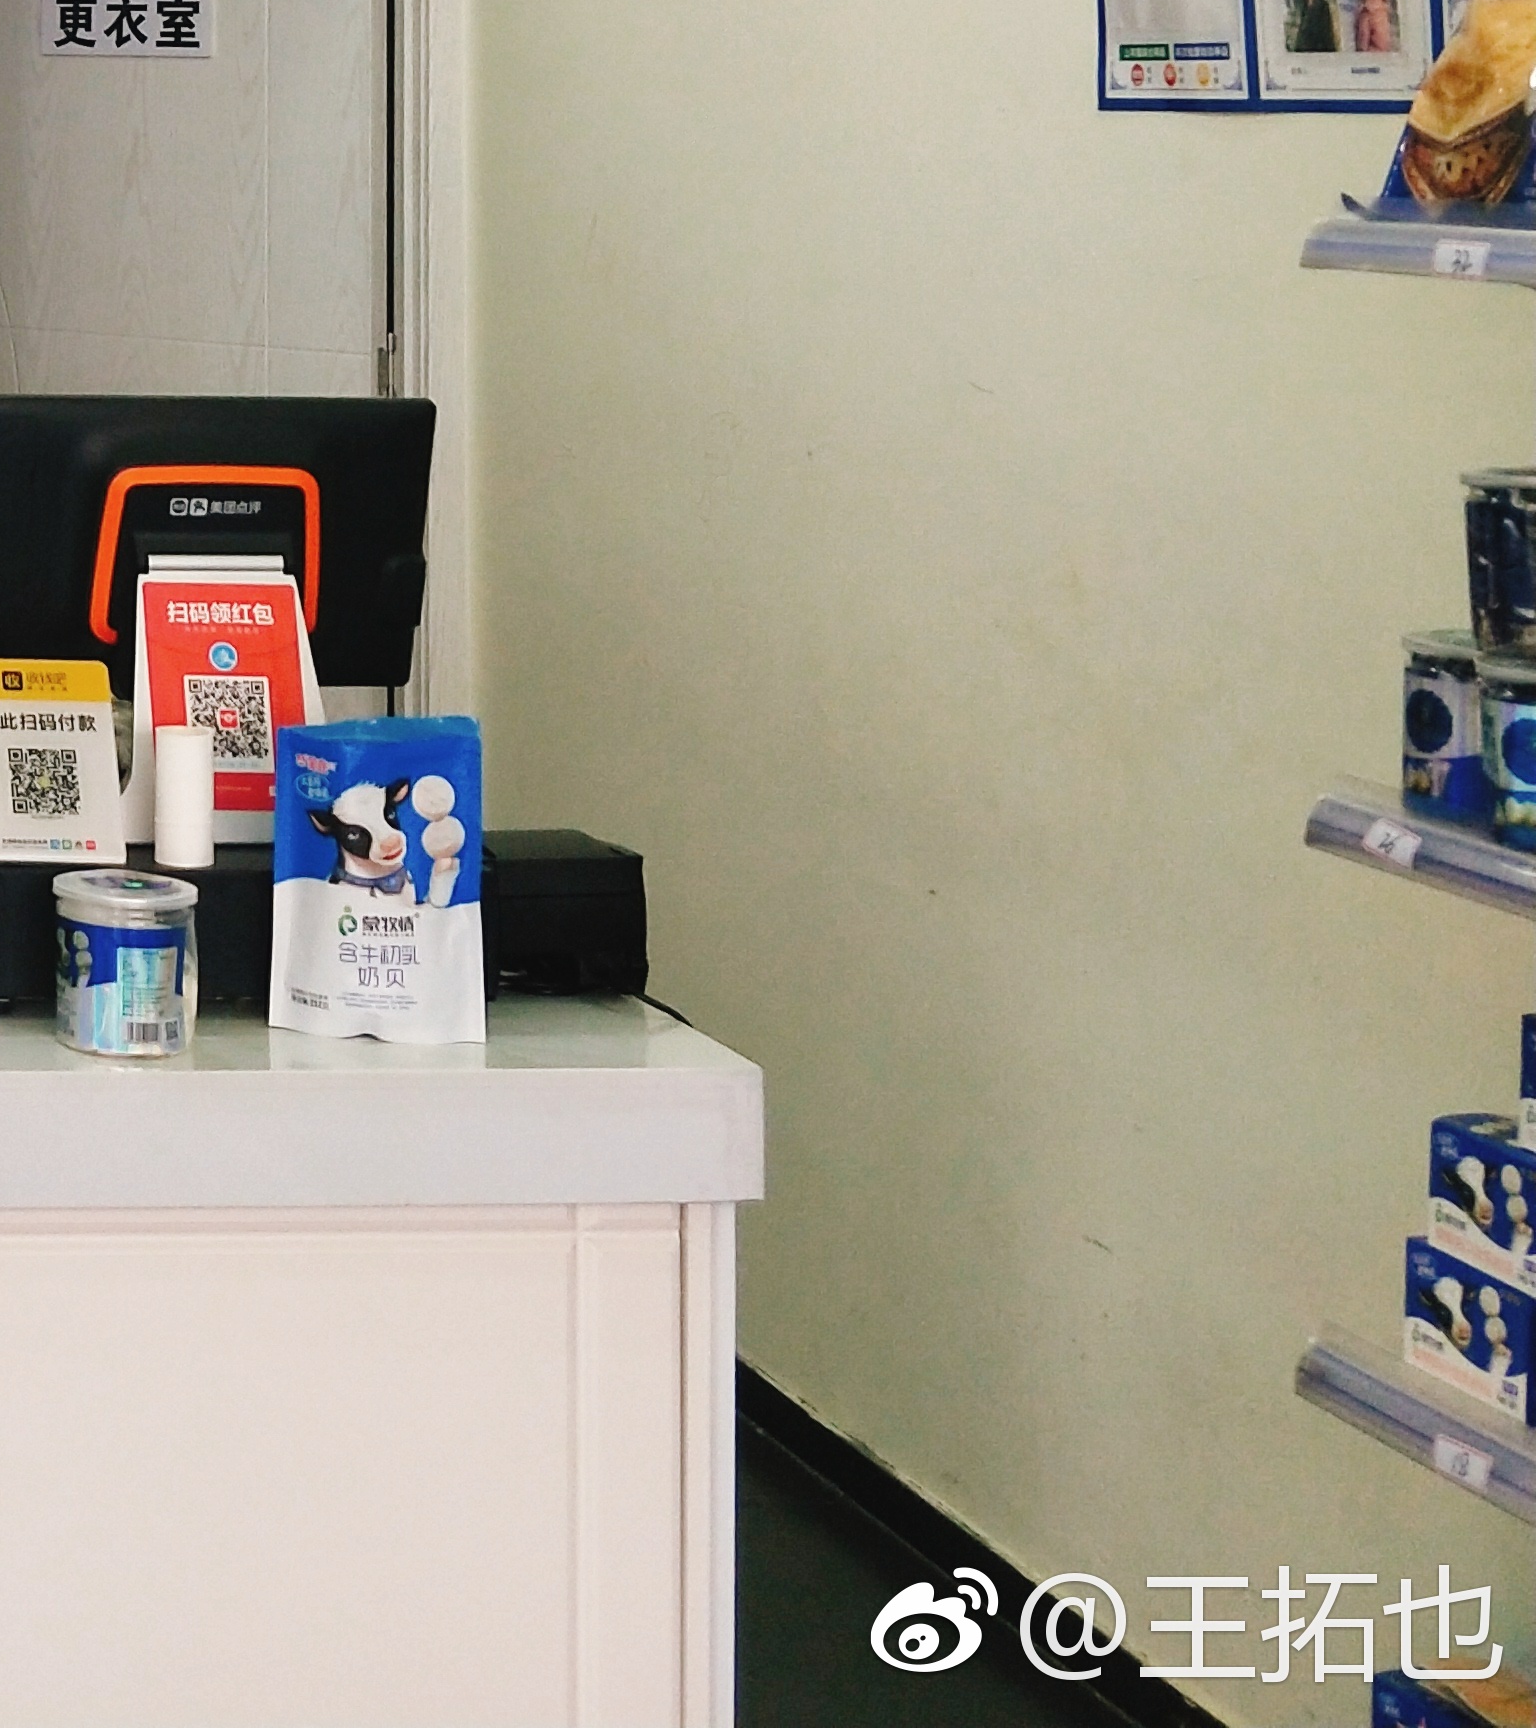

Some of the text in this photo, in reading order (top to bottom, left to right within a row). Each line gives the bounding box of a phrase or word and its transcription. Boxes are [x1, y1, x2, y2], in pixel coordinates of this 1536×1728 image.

[166, 600, 275, 626] 扫码领红包
[338, 941, 421, 966] 含牛初乳
[357, 965, 406, 989] 奶贝
